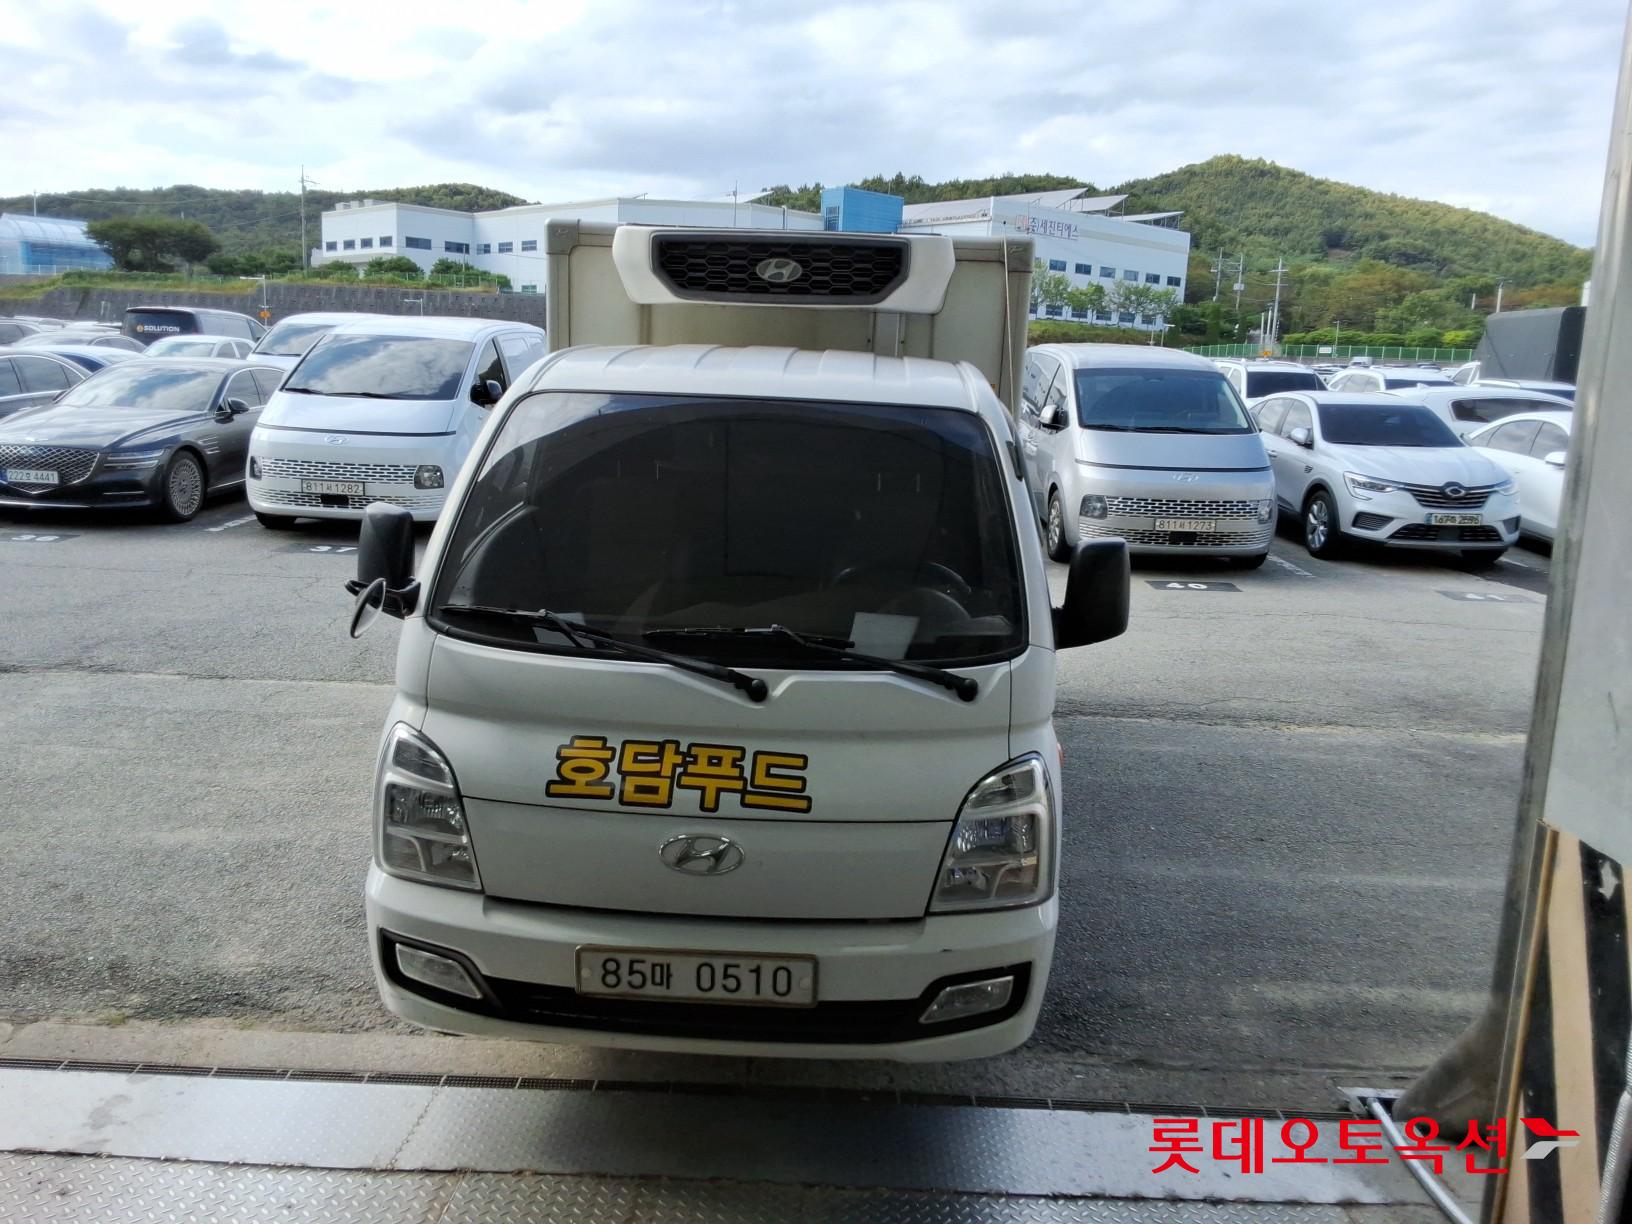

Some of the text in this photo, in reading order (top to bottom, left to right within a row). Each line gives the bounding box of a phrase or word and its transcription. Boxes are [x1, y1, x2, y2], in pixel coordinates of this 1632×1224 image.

[545, 735, 812, 813] 호담푸드
[601, 957, 792, 997] 85마 0510
